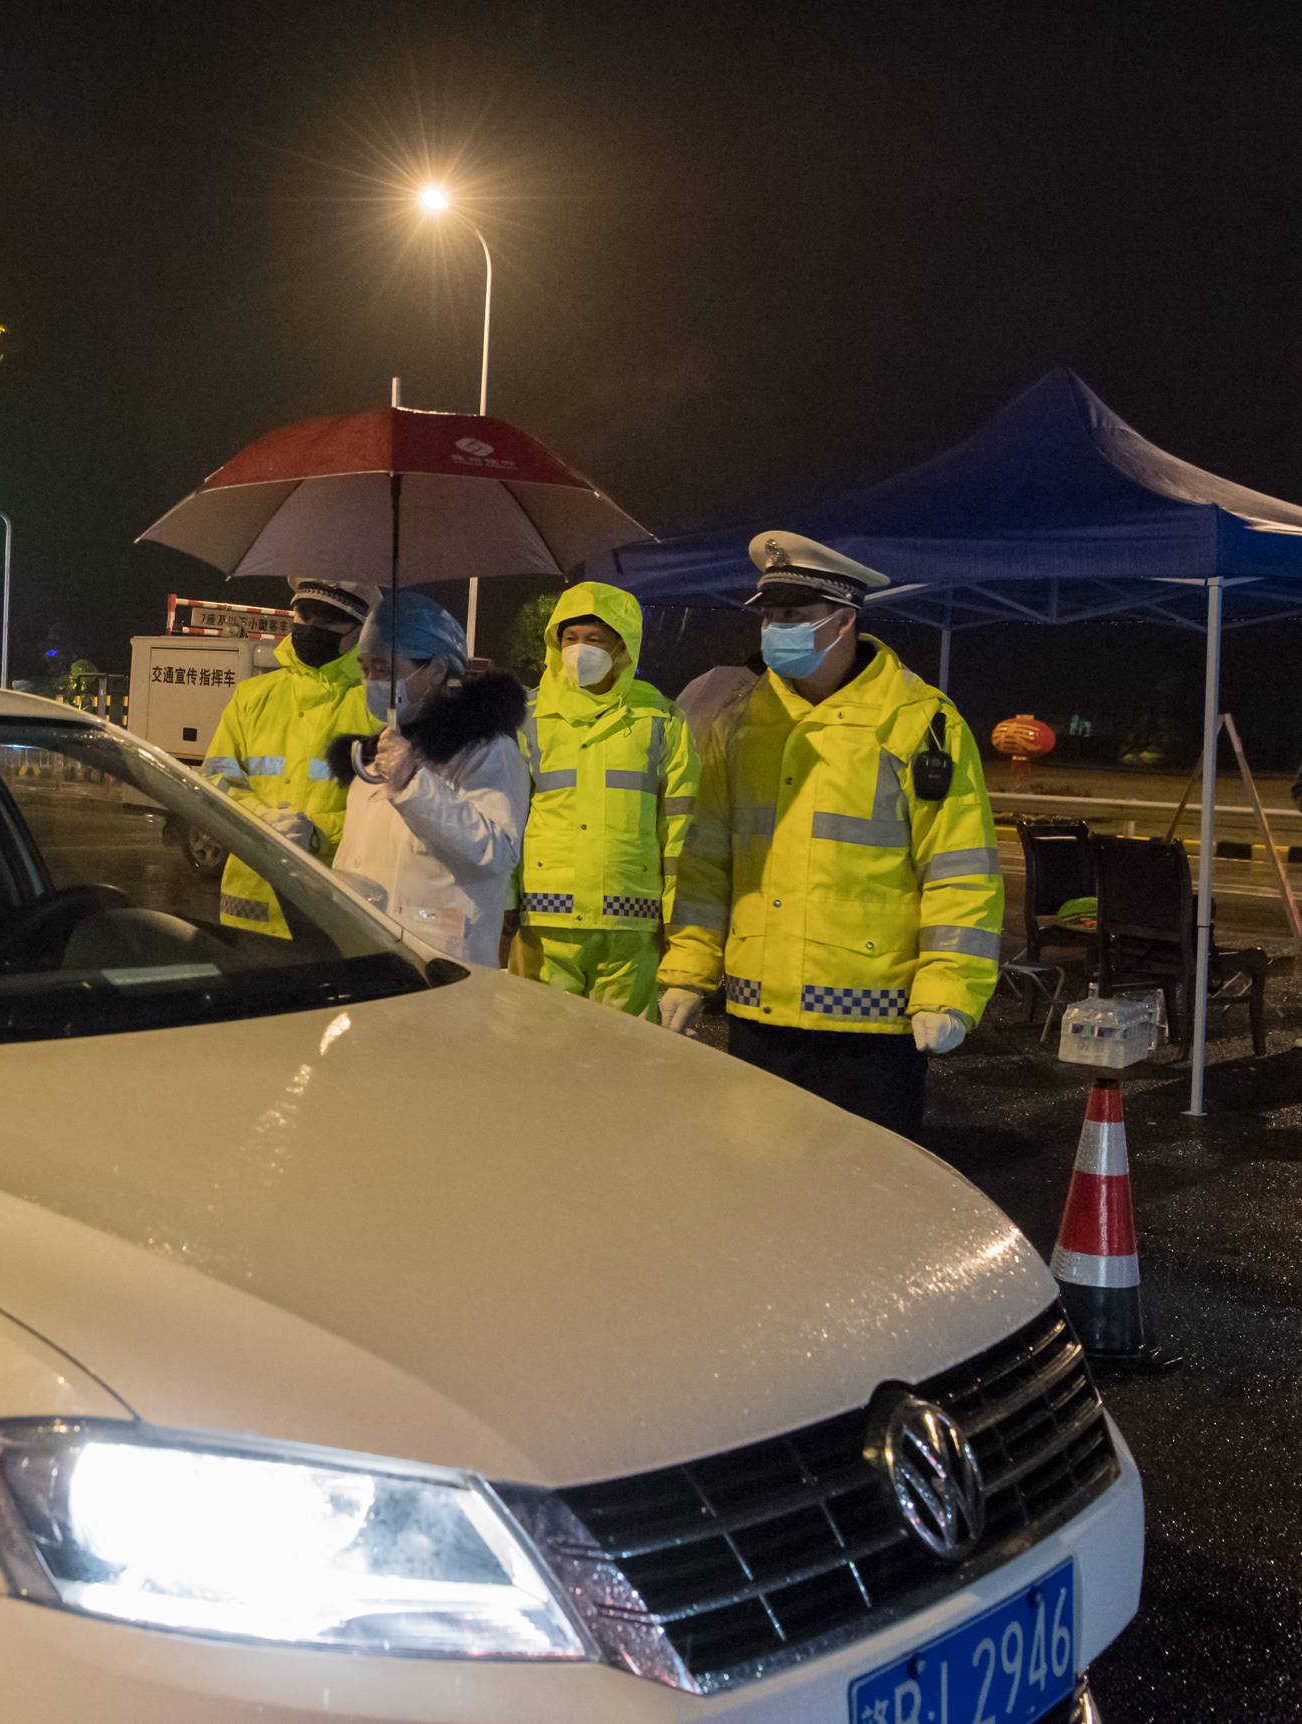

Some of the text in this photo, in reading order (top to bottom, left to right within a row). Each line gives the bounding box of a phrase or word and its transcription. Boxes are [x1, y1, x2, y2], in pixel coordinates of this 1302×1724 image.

[151, 665, 236, 688] 交通宣传指挥车
